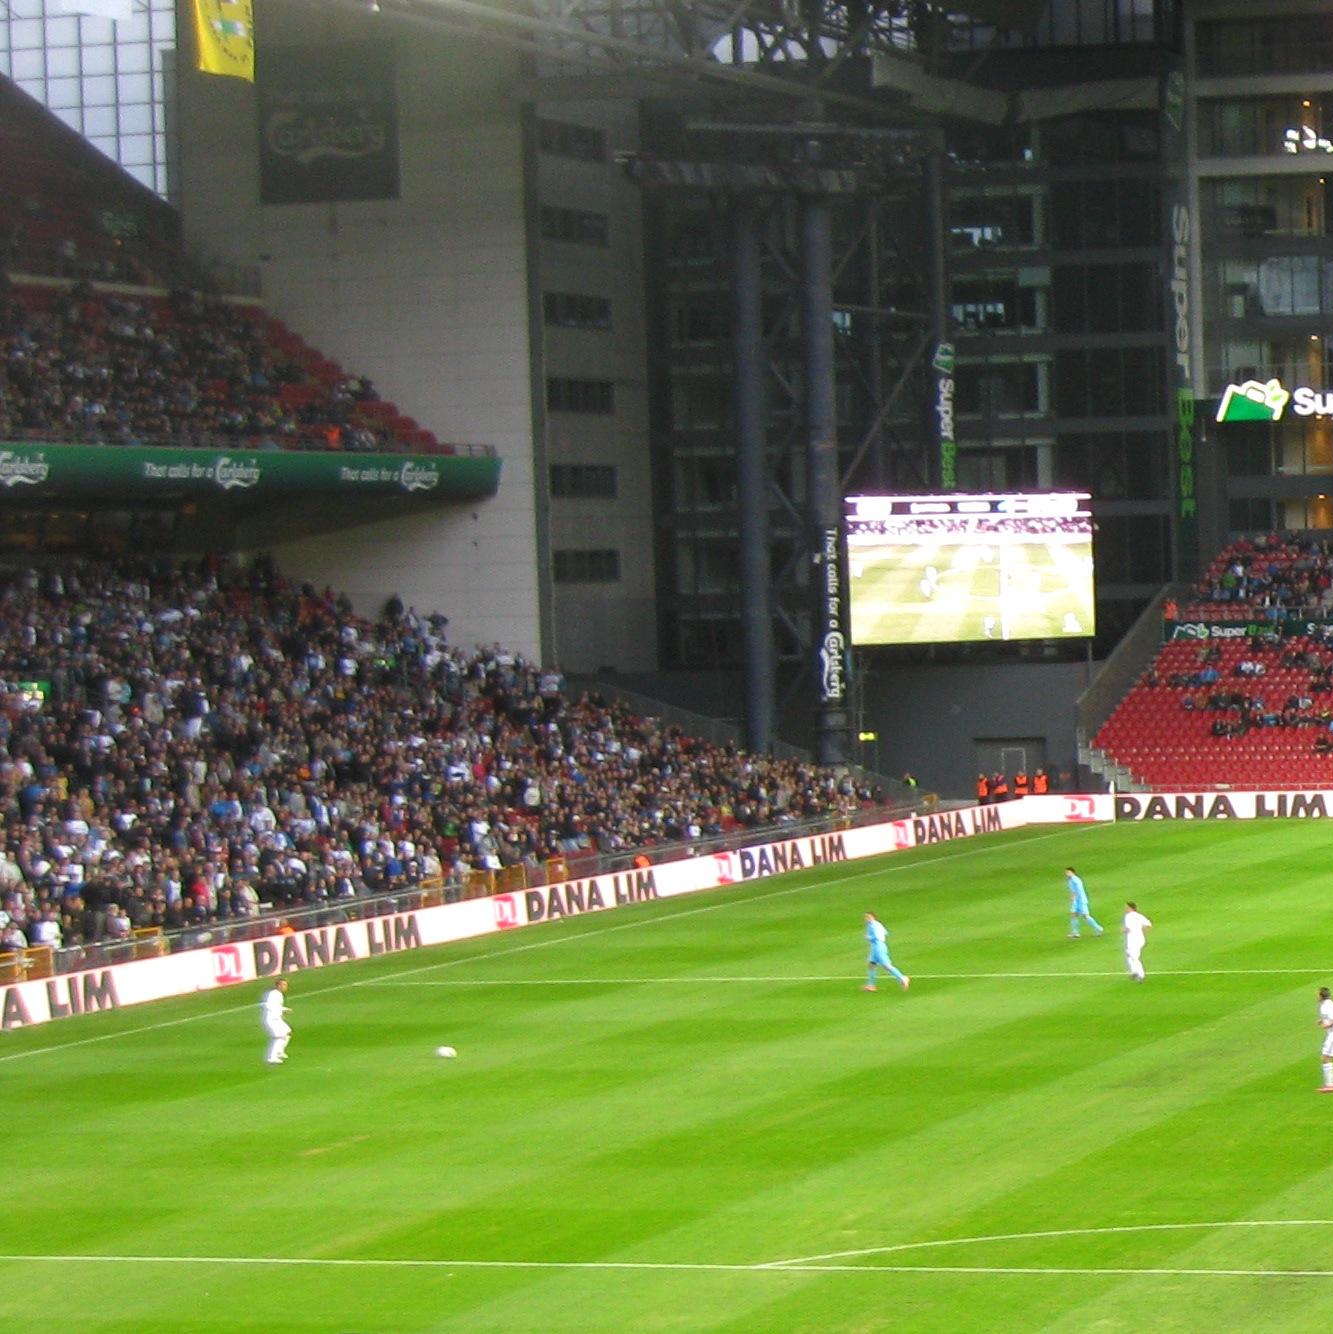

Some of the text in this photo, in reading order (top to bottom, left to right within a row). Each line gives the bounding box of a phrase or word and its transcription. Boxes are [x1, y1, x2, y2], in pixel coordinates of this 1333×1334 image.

[214, 457, 259, 489] Carlsberg
[401, 461, 440, 492] Carlsberg
[1210, 625, 1248, 639] Super
[820, 630, 847, 700] Carlsberg
[913, 804, 1001, 846] DANA LIM
[1115, 793, 1329, 820] DANA LIM
[739, 833, 848, 879] DANA LIM
[526, 869, 659, 923] DANA LIM
[253, 914, 422, 978] DANA LIM
[45, 970, 121, 1020] LIM
